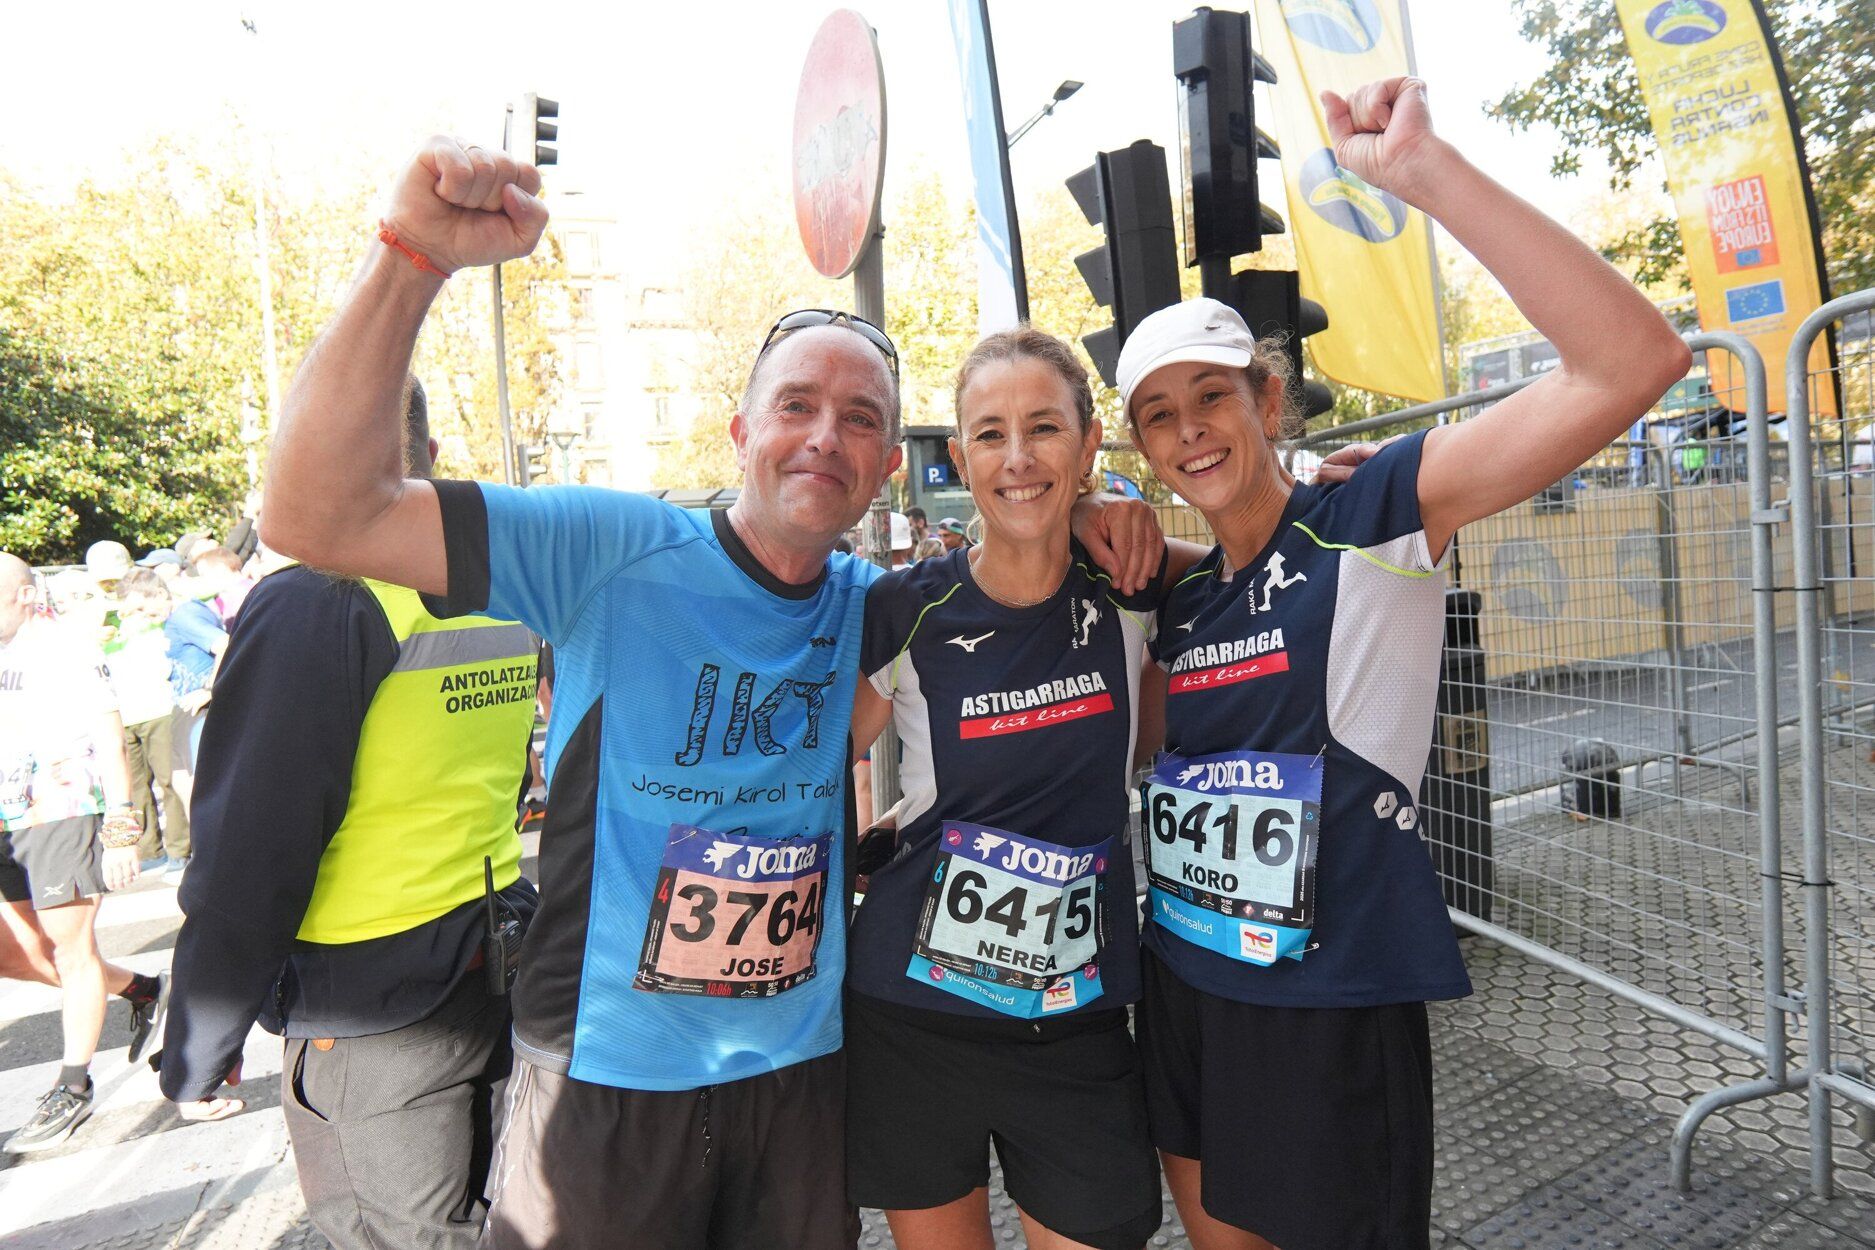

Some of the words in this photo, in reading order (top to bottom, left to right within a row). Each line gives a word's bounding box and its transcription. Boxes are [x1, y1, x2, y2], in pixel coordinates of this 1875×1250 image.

[1171, 628, 1285, 674] ASTIGARRAGA
[1182, 674, 1209, 687] kit
[1215, 664, 1260, 680] line
[961, 671, 1107, 718] ASTIGARRAGA
[675, 663, 837, 766] JKT
[989, 716, 1029, 731] kit
[1036, 704, 1088, 721] line
[631, 774, 725, 805] Josemi
[1197, 760, 1284, 791] Joma
[1152, 792, 1295, 867] 6416
[736, 843, 817, 878] Joma
[933, 861, 945, 883] 6
[1001, 840, 1095, 881] Joma
[657, 877, 670, 904] 4
[1182, 862, 1239, 893] KORO
[670, 881, 818, 947] 3764
[946, 870, 1093, 946] 6415
[1263, 909, 1283, 920] delta
[720, 956, 785, 977] JOSE
[974, 963, 998, 980] 10:12h
[976, 940, 1057, 972] NEREA
